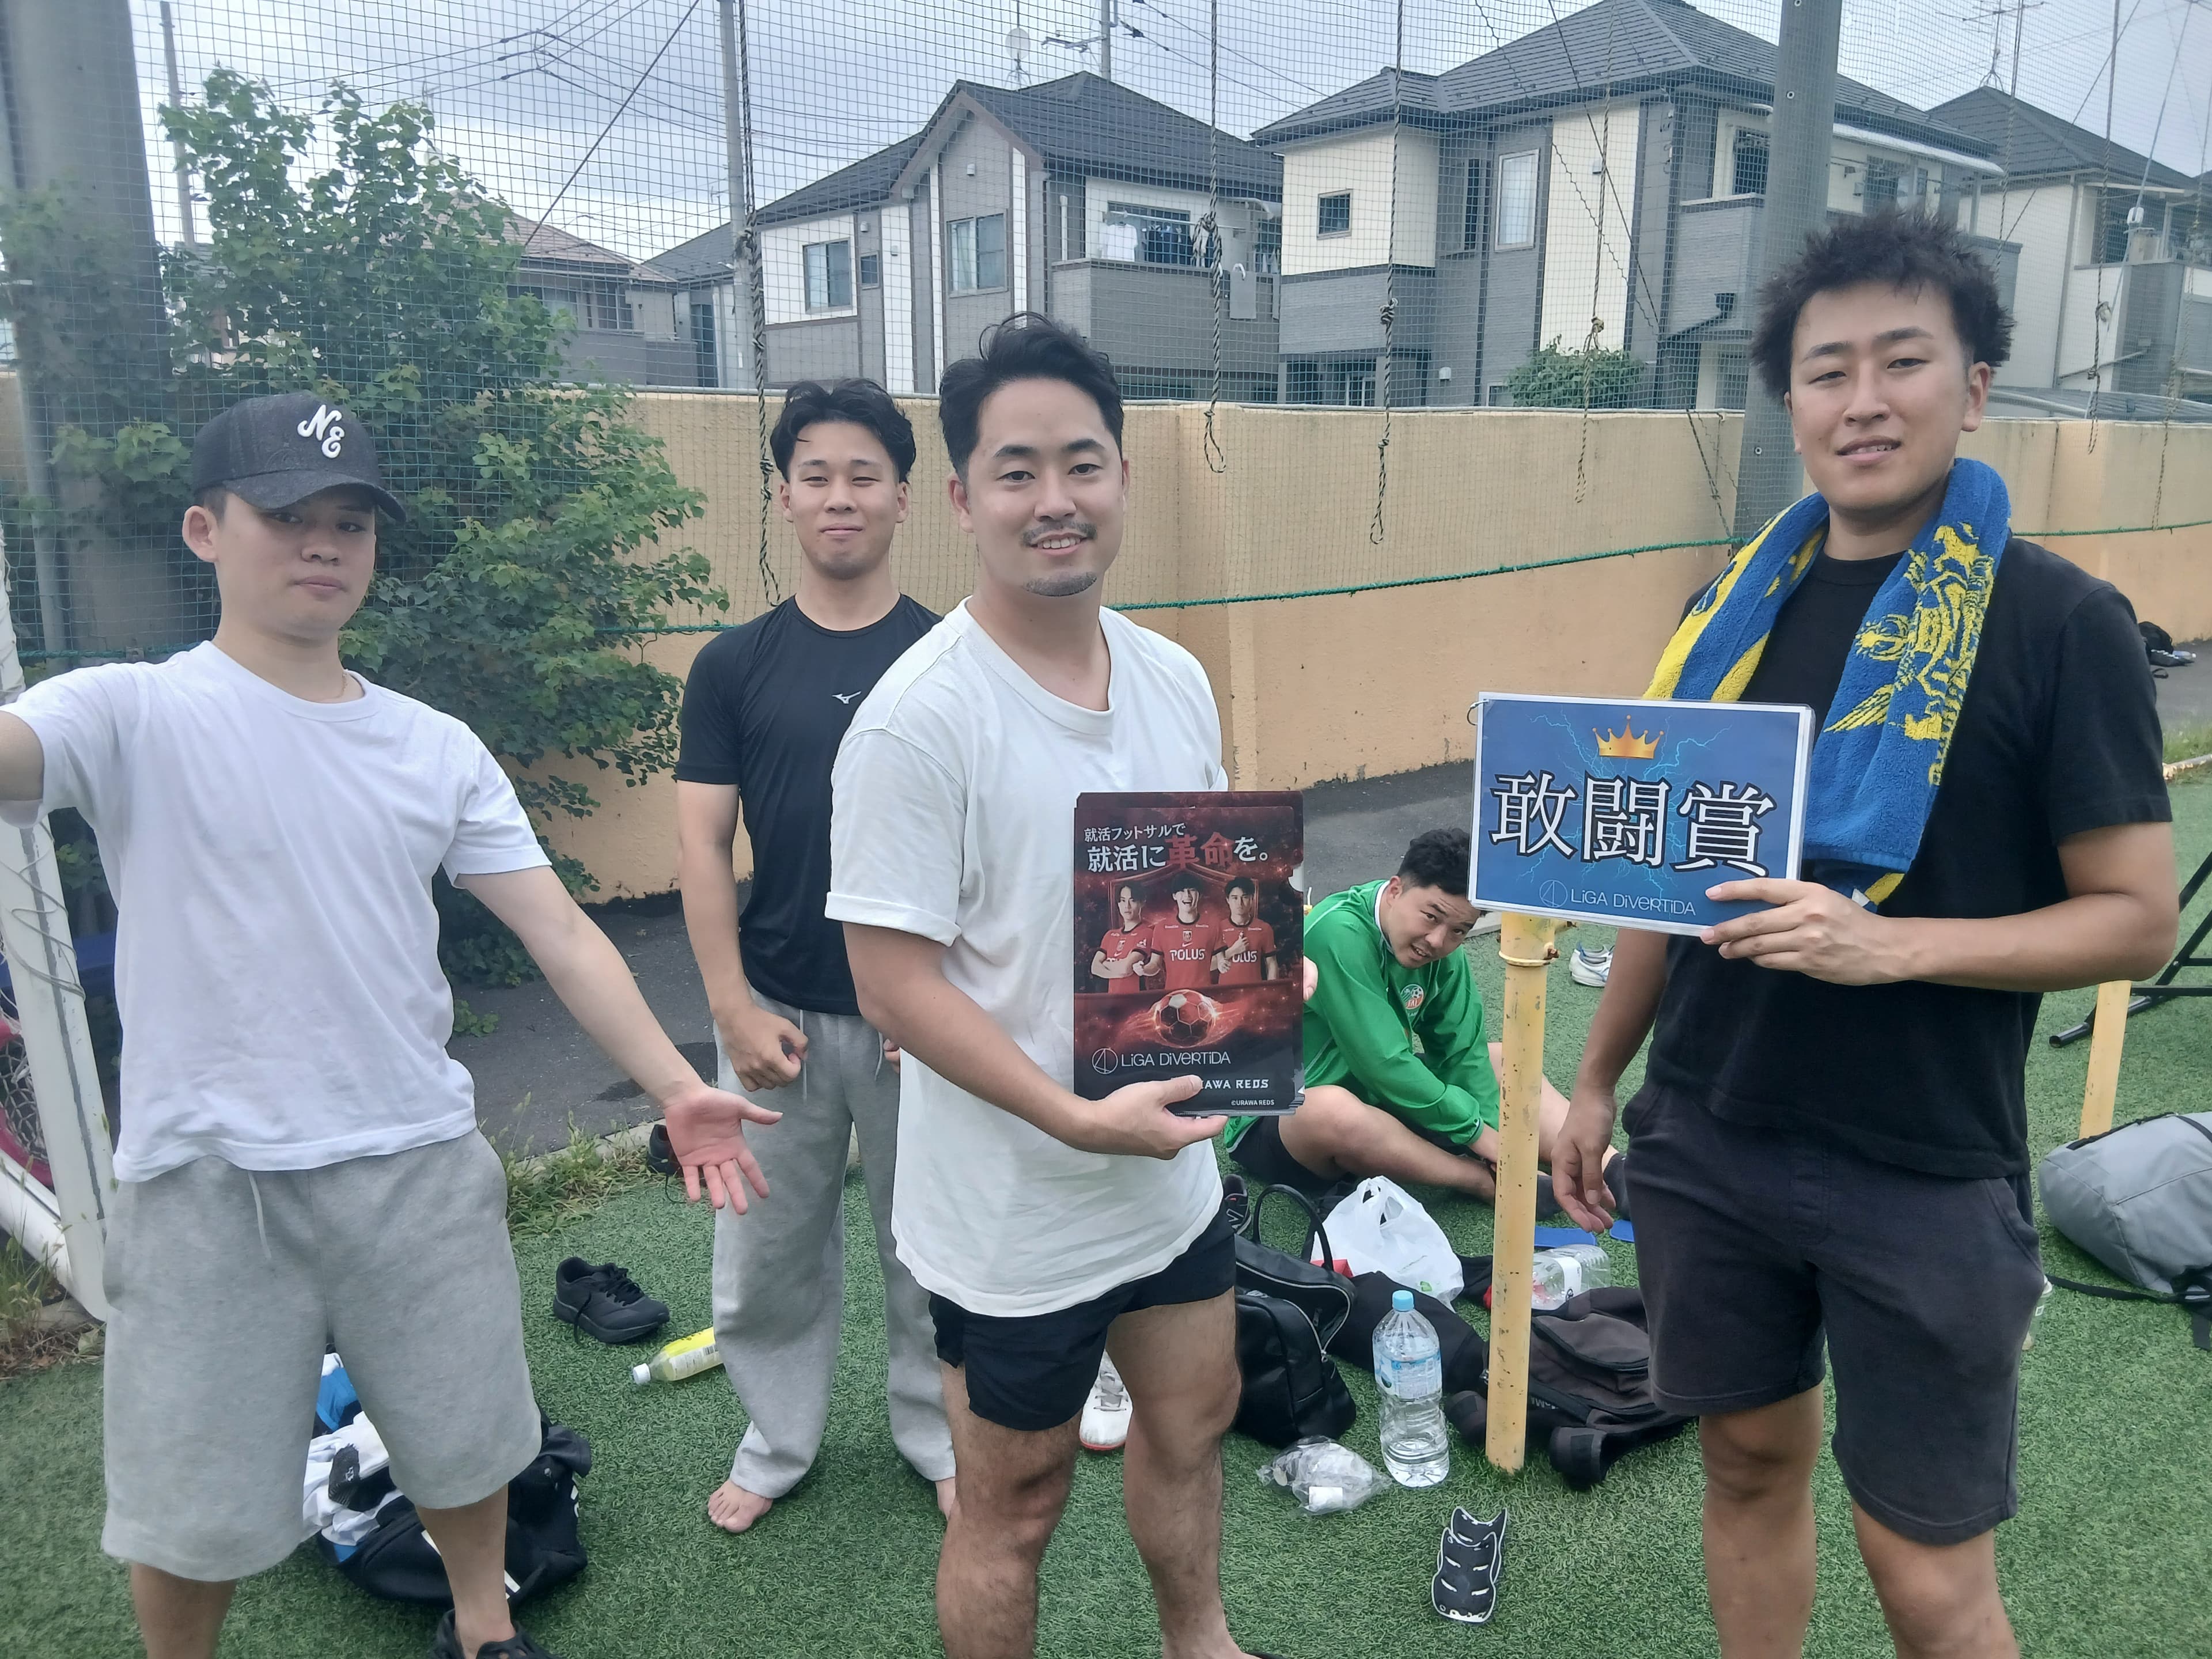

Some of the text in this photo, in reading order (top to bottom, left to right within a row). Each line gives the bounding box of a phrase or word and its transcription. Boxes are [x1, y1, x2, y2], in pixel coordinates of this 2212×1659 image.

[1490, 770, 1778, 878] 敢闘賞
[1084, 823, 1186, 842] 就活フットサルで
[1087, 831, 1268, 873] 就活に革命を。
[1169, 949, 1206, 961] POLUS
[1232, 950, 1257, 963] OLUS
[1202, 1079, 1269, 1089] AWA REDS
